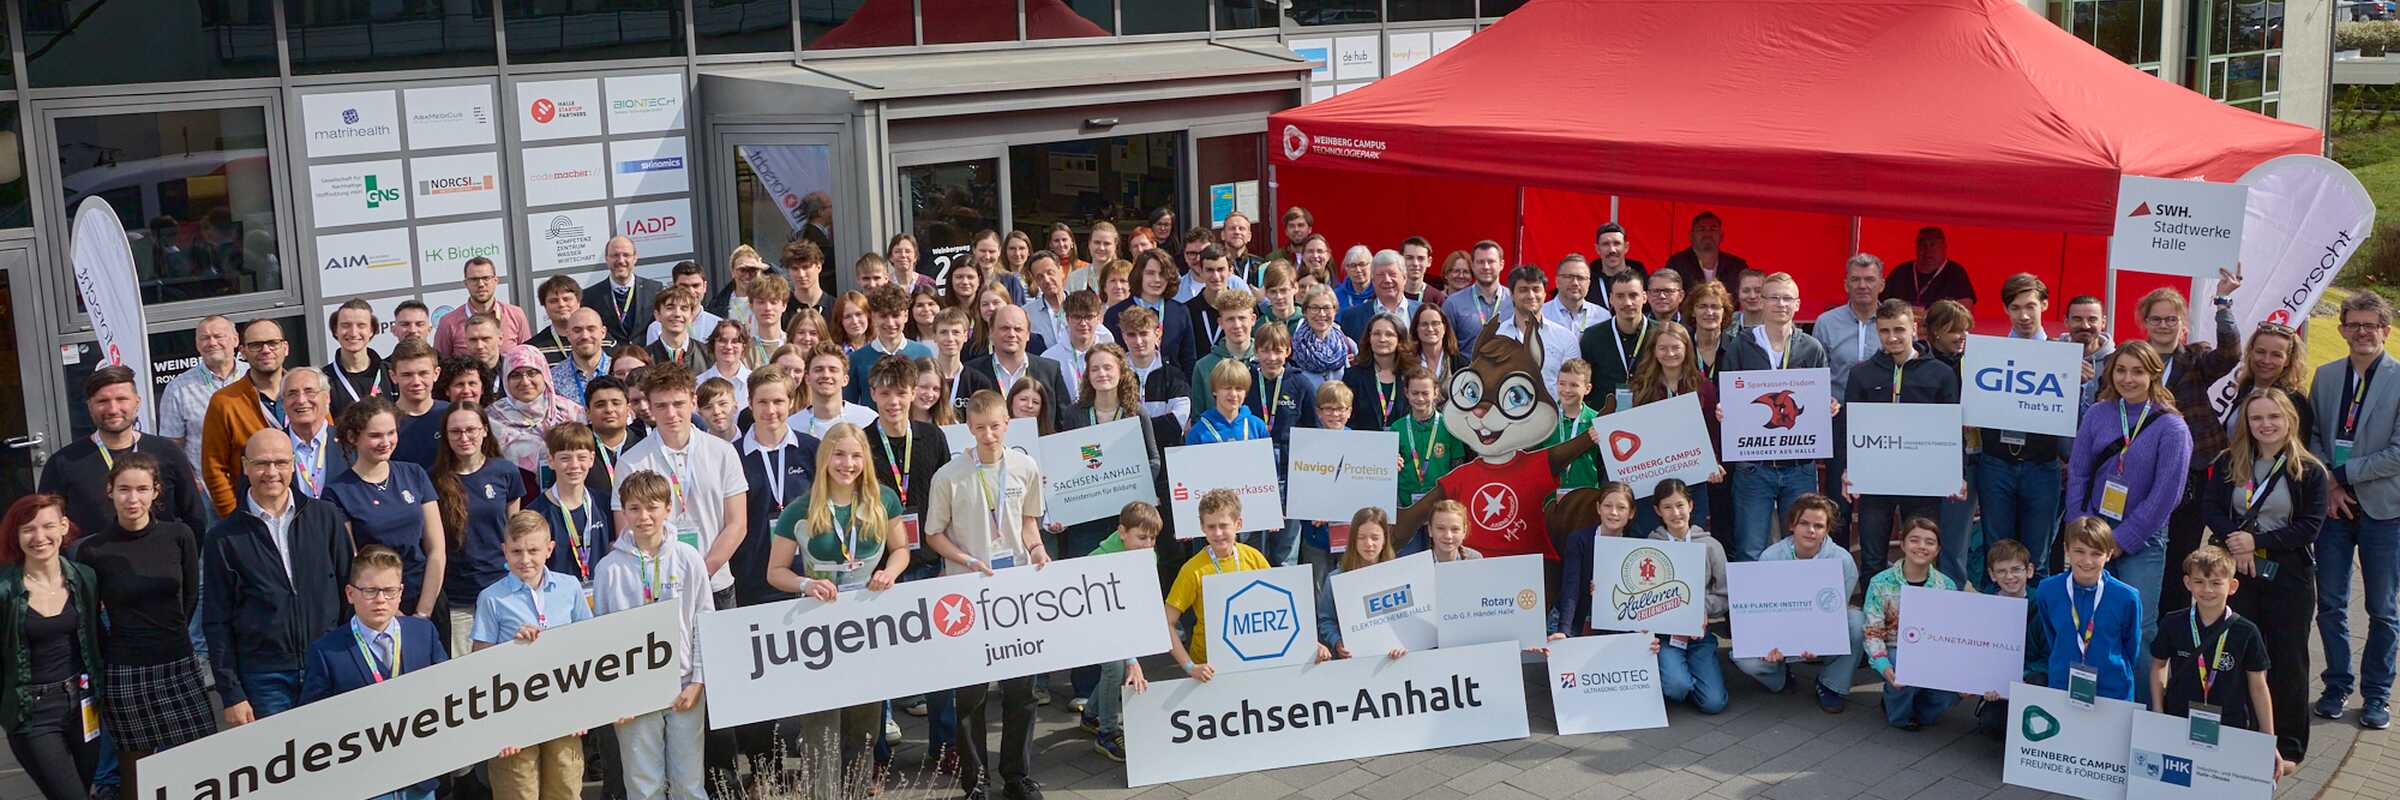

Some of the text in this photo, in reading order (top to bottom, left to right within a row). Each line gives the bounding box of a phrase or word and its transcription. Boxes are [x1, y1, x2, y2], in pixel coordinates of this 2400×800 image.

[314, 125, 391, 141] matrihealth
[1312, 135, 1387, 150] WEINBERG CAMPUS
[1312, 145, 1381, 160] TECHNOLOGIEPARK
[431, 176, 473, 189] NORCSI
[2155, 204, 2192, 218] SWH.
[626, 216, 677, 236] IADP
[2153, 220, 2231, 239] Stadtwerke
[556, 244, 586, 252] ZENTRUM
[2151, 236, 2187, 251] Halle
[425, 243, 500, 263] HK Biotech
[324, 254, 368, 270] AIM
[2282, 229, 2352, 313] forscht
[2018, 400, 2064, 414] That's IT.
[1738, 434, 1817, 448] SAALE BULLS
[1294, 461, 1389, 476] Navigo Proteins
[1616, 447, 1702, 476] WEINBERG CAMPUS
[1053, 464, 1141, 492] SACHSEN-ANHALT
[1369, 591, 1406, 613] ECH
[1408, 604, 1432, 617] HALLE
[1481, 597, 1514, 608] Rotary
[1618, 586, 1680, 621] Halloren
[750, 572, 1126, 680] jugend forscht
[1233, 609, 1289, 636] MERZ
[983, 638, 1044, 666] junior
[1581, 669, 1649, 686] SONOTEC
[1170, 674, 1482, 743] Sachsen-Anhalt
[2020, 746, 2127, 774] WEINBERG CAMPUS
[2020, 758, 2064, 773] FREUNDE
[2065, 767, 2072, 775] &
[2164, 758, 2190, 774] IHK
